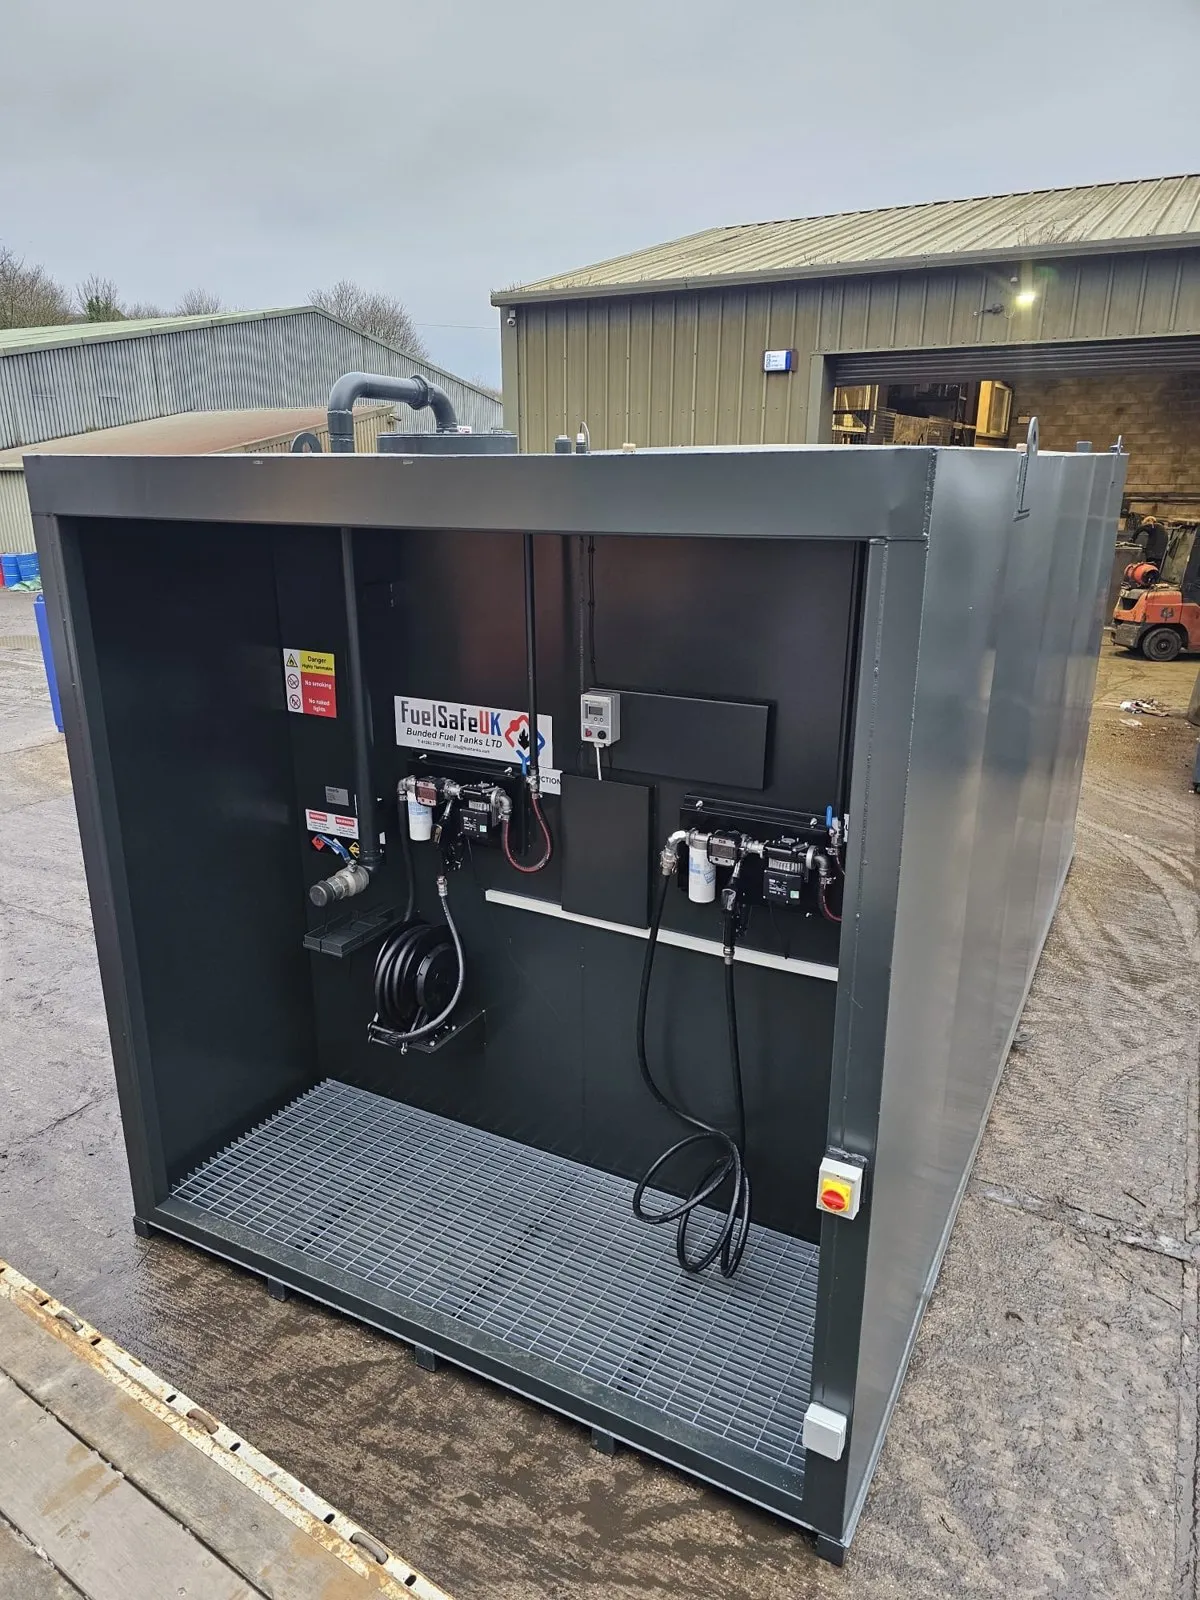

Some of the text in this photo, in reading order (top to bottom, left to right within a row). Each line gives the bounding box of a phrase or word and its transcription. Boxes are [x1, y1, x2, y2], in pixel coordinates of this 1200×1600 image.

[308, 656, 326, 664] Danger
[312, 681, 332, 690] smoking
[406, 728, 437, 738] Bunded
[439, 732, 456, 742] Fuel
[459, 735, 483, 745] Tanks
[486, 738, 502, 748] LTD
